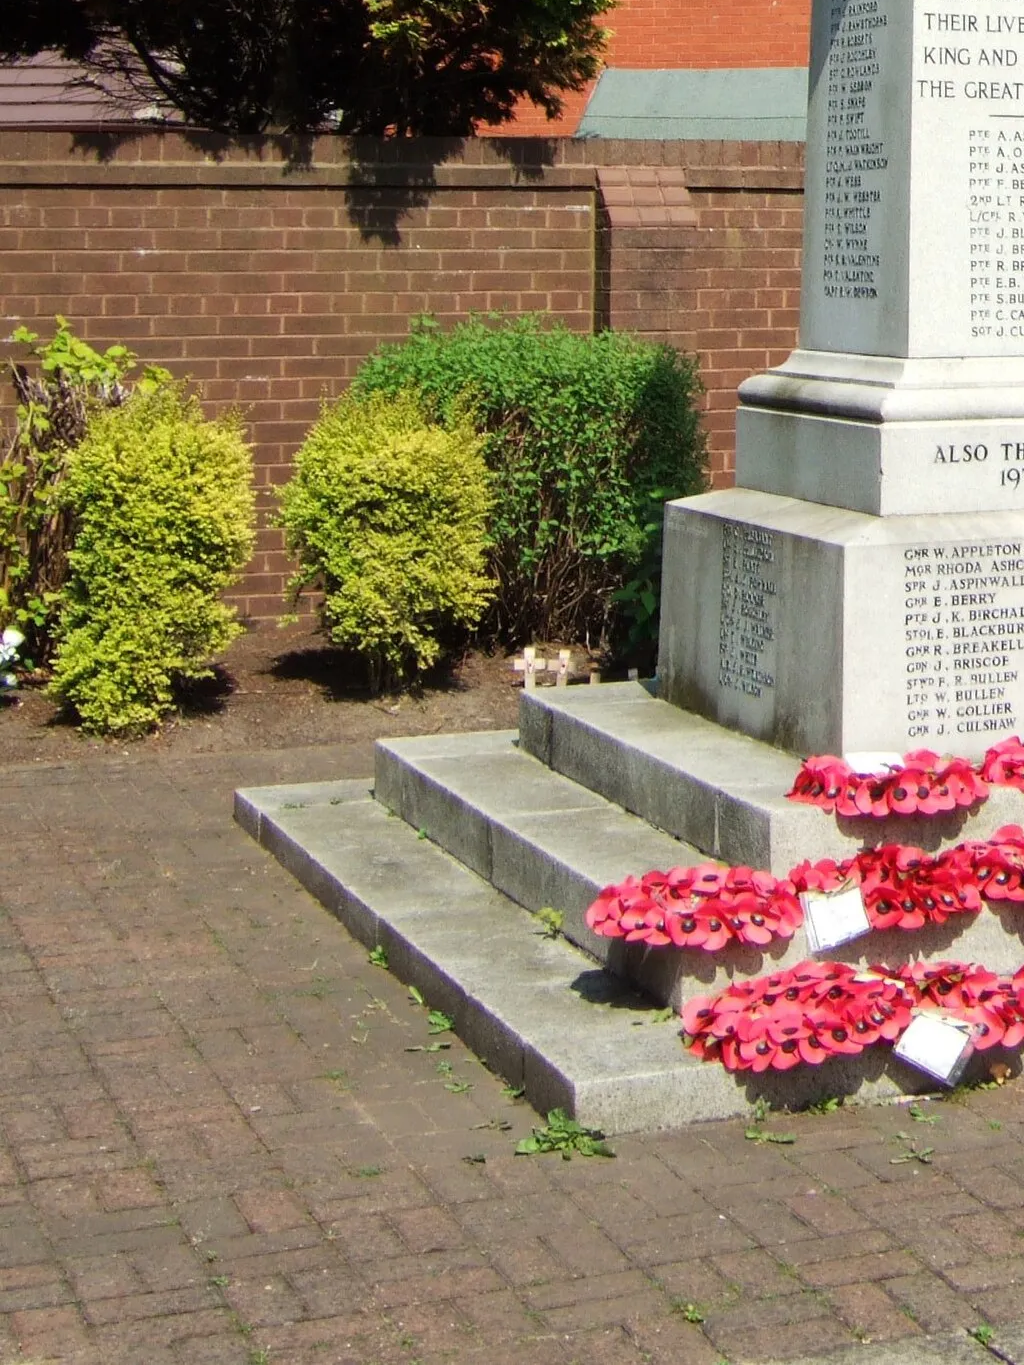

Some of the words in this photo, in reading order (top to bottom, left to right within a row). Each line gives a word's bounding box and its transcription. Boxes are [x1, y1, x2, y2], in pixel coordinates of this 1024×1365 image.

[924, 13, 978, 31] THEIR
[924, 47, 970, 65] KING
[978, 50, 1017, 66] AND
[917, 80, 955, 98] THE
[964, 82, 1023, 100] GREAT
[969, 130, 990, 141] PTE
[969, 146, 990, 157] PTE
[969, 162, 989, 173] PTE
[969, 179, 990, 190] PTE
[970, 228, 990, 238] PTE
[970, 244, 990, 254] PTE
[970, 261, 990, 271] PTE
[970, 278, 990, 288] PTE
[970, 294, 990, 304] PTE
[970, 310, 990, 320] PTE
[934, 444, 988, 463] ALSO
[904, 548, 929, 560] GNR
[952, 544, 1021, 559] APPLETON
[937, 562, 981, 575] RHODA
[905, 580, 926, 592] SPR
[952, 593, 996, 606] BERRY
[905, 613, 927, 625] PTE
[953, 639, 1024, 654] BREAKELL
[954, 655, 1009, 670] BRISCOE
[956, 688, 1005, 701] BULLEN
[956, 703, 1012, 717] COLLIER
[957, 718, 1016, 732] CULSHAW
